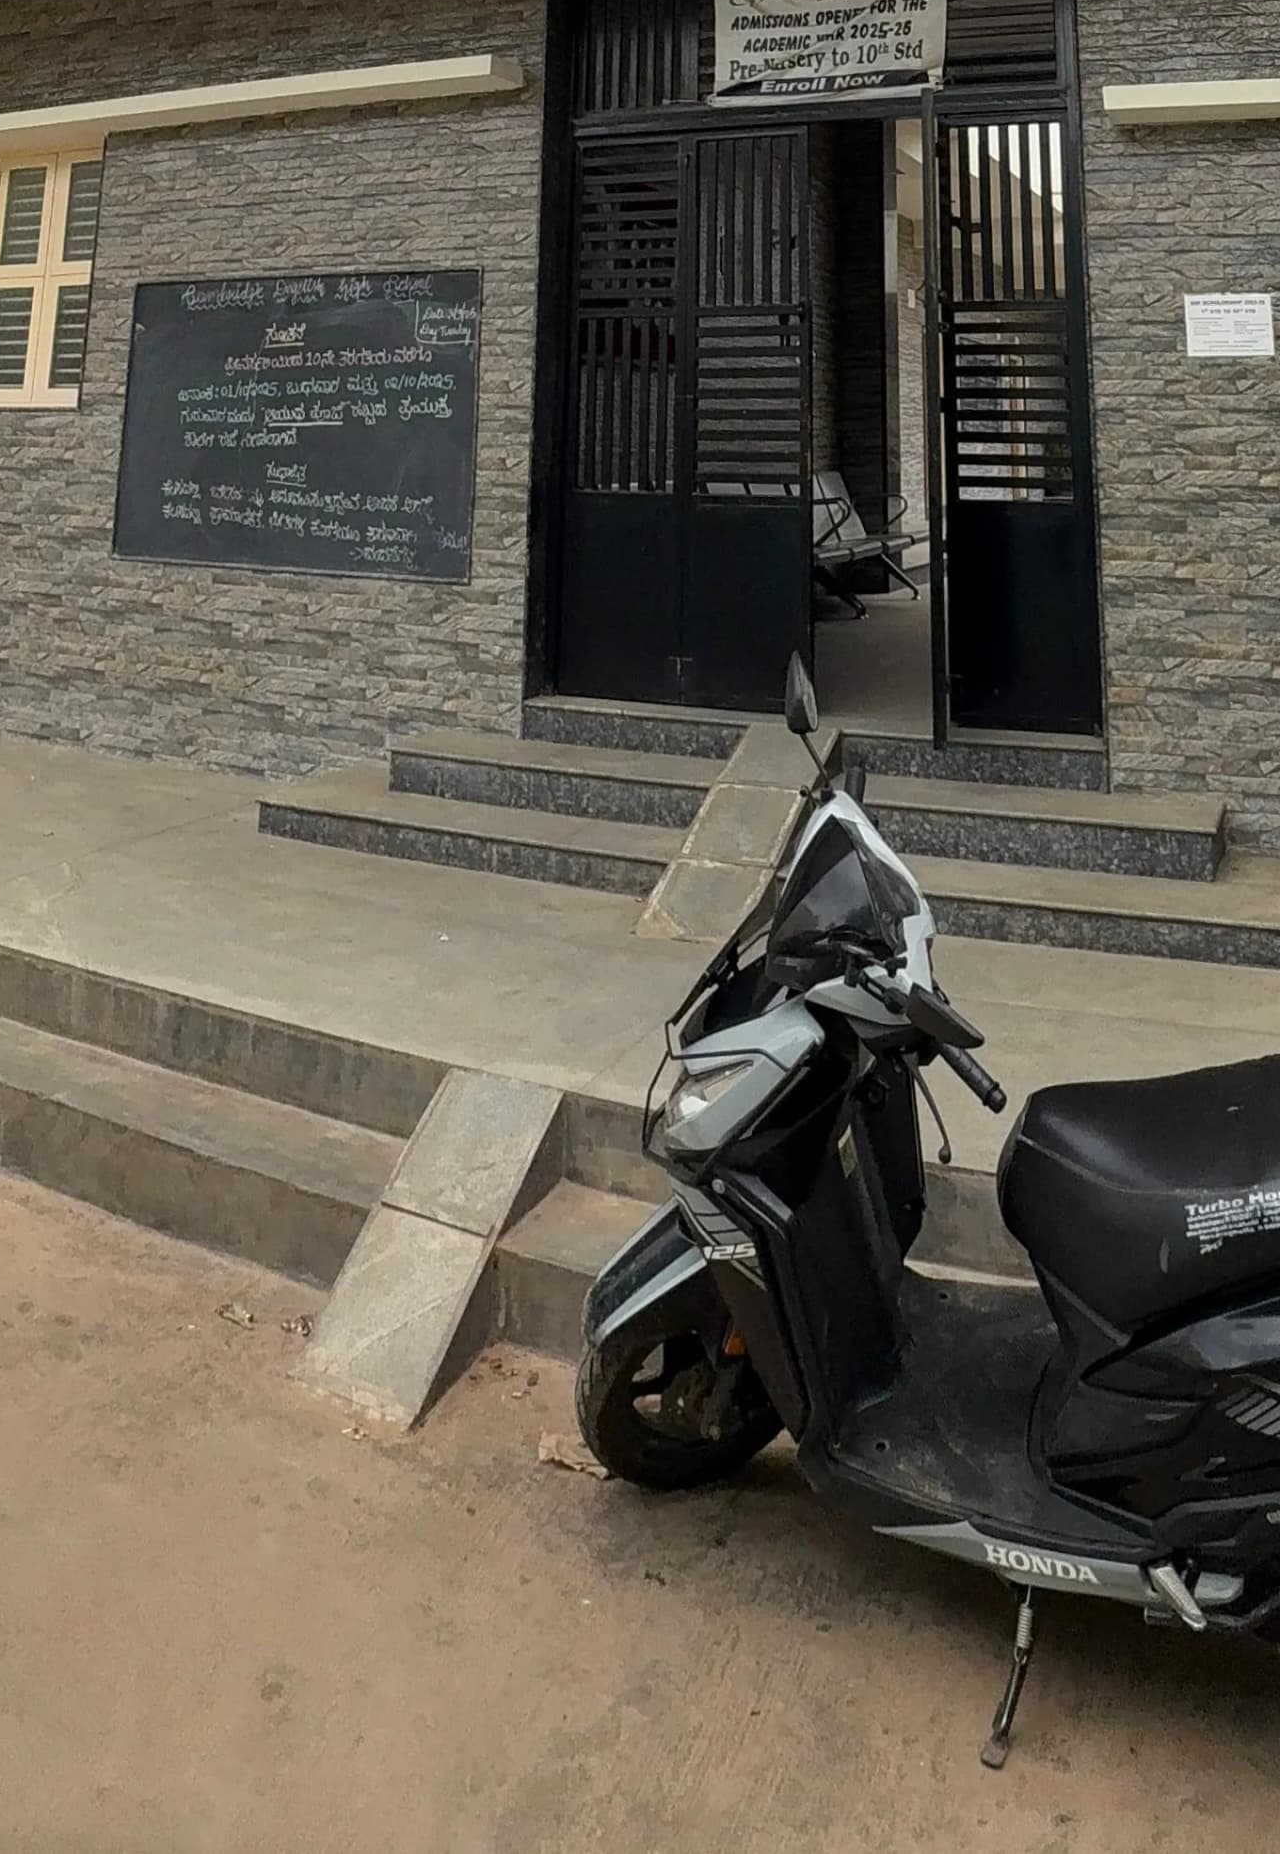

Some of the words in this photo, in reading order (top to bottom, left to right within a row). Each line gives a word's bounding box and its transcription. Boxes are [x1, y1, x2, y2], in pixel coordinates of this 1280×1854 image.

[731, 11, 810, 31] ADMISSIONS
[743, 33, 811, 53] ACADEMIC
[832, 47, 850, 68] to
[856, 41, 888, 65] 10th
[894, 38, 924, 61] Std
[760, 76, 828, 94] Enroll
[833, 72, 885, 91] Now
[1184, 1197, 1245, 1217] Turbo
[982, 1542, 1100, 1586] HONDA
